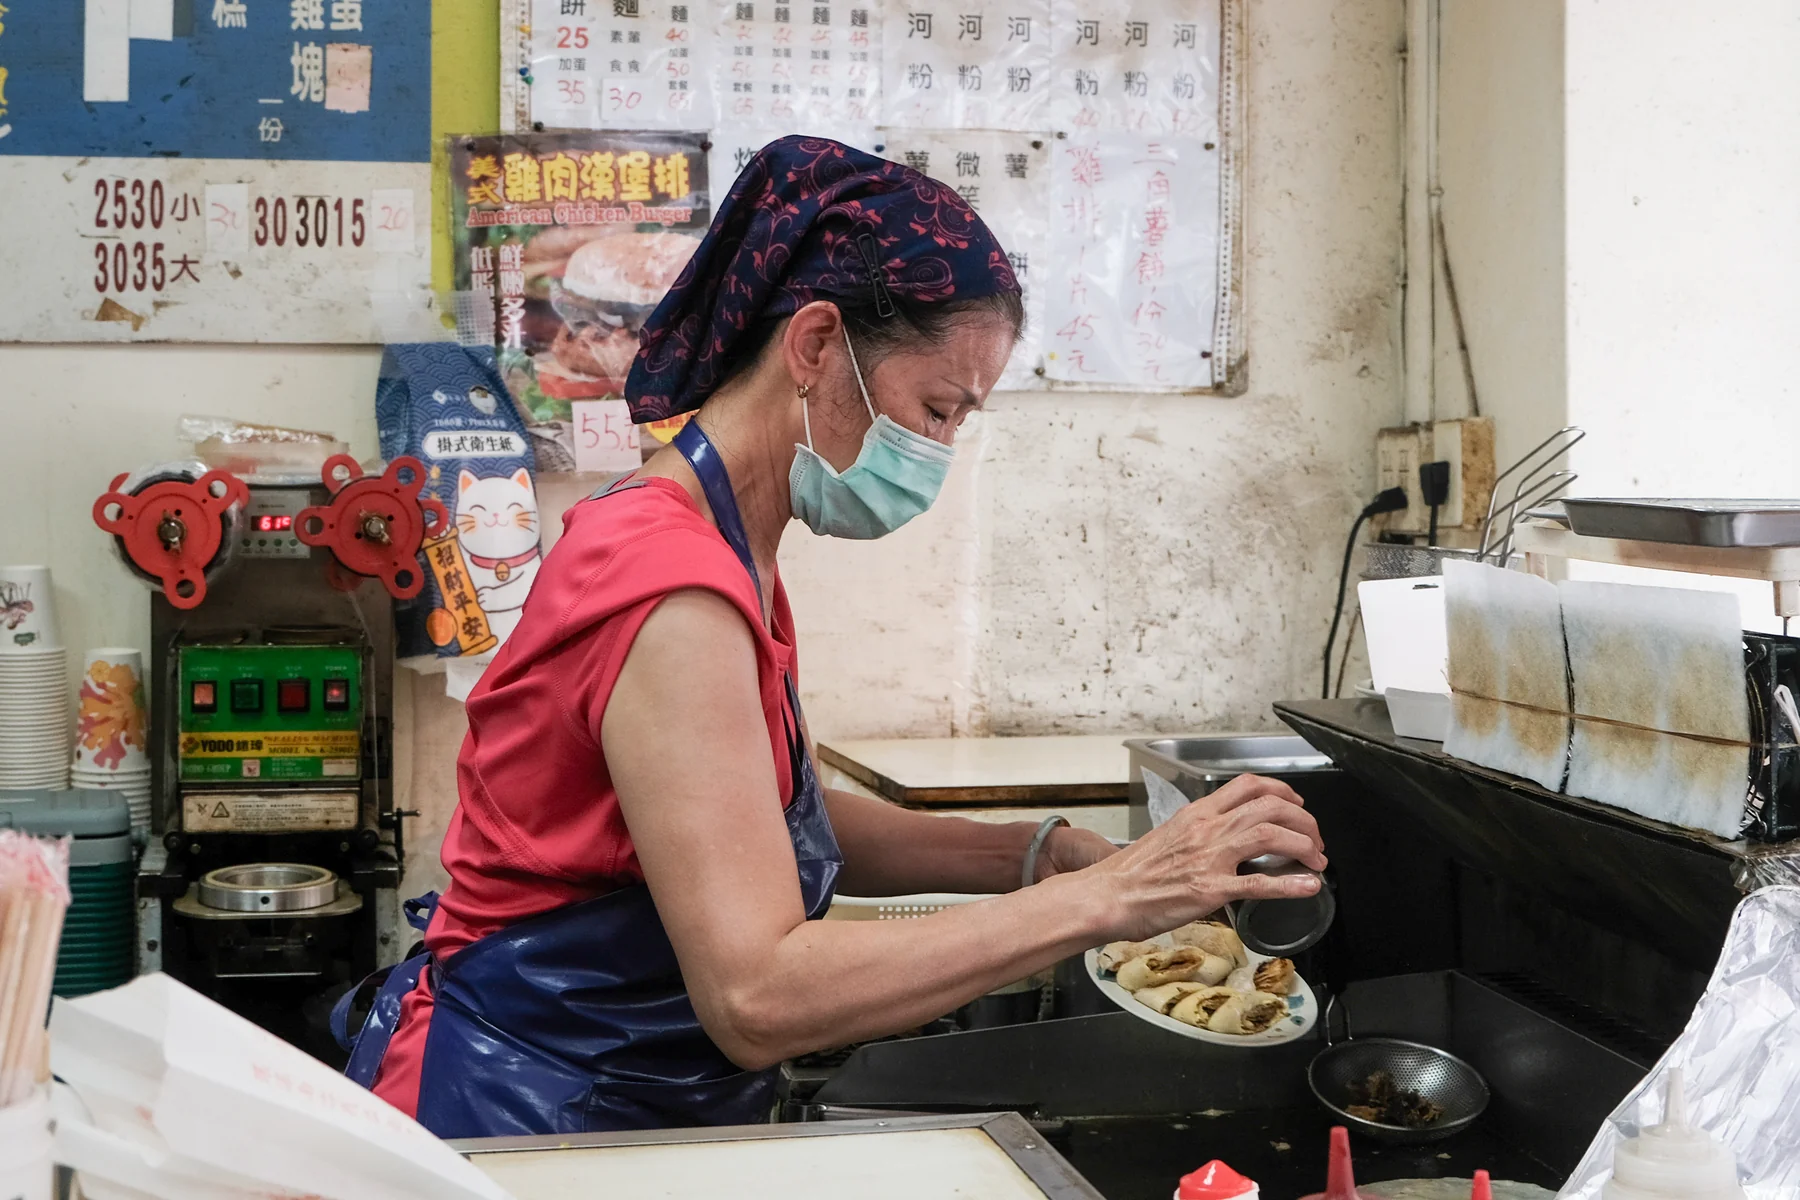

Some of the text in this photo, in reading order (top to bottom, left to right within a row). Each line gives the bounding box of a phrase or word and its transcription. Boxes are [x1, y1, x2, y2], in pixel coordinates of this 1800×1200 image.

[557, 26, 589, 49] 25
[559, 58, 586, 71] 加蛋
[667, 61, 690, 78] 50
[557, 80, 585, 104] 35
[609, 88, 642, 111] 30
[466, 201, 692, 228] American Chicken Burger
[436, 545, 484, 641] 招財平安
[201, 739, 234, 752] YODO
